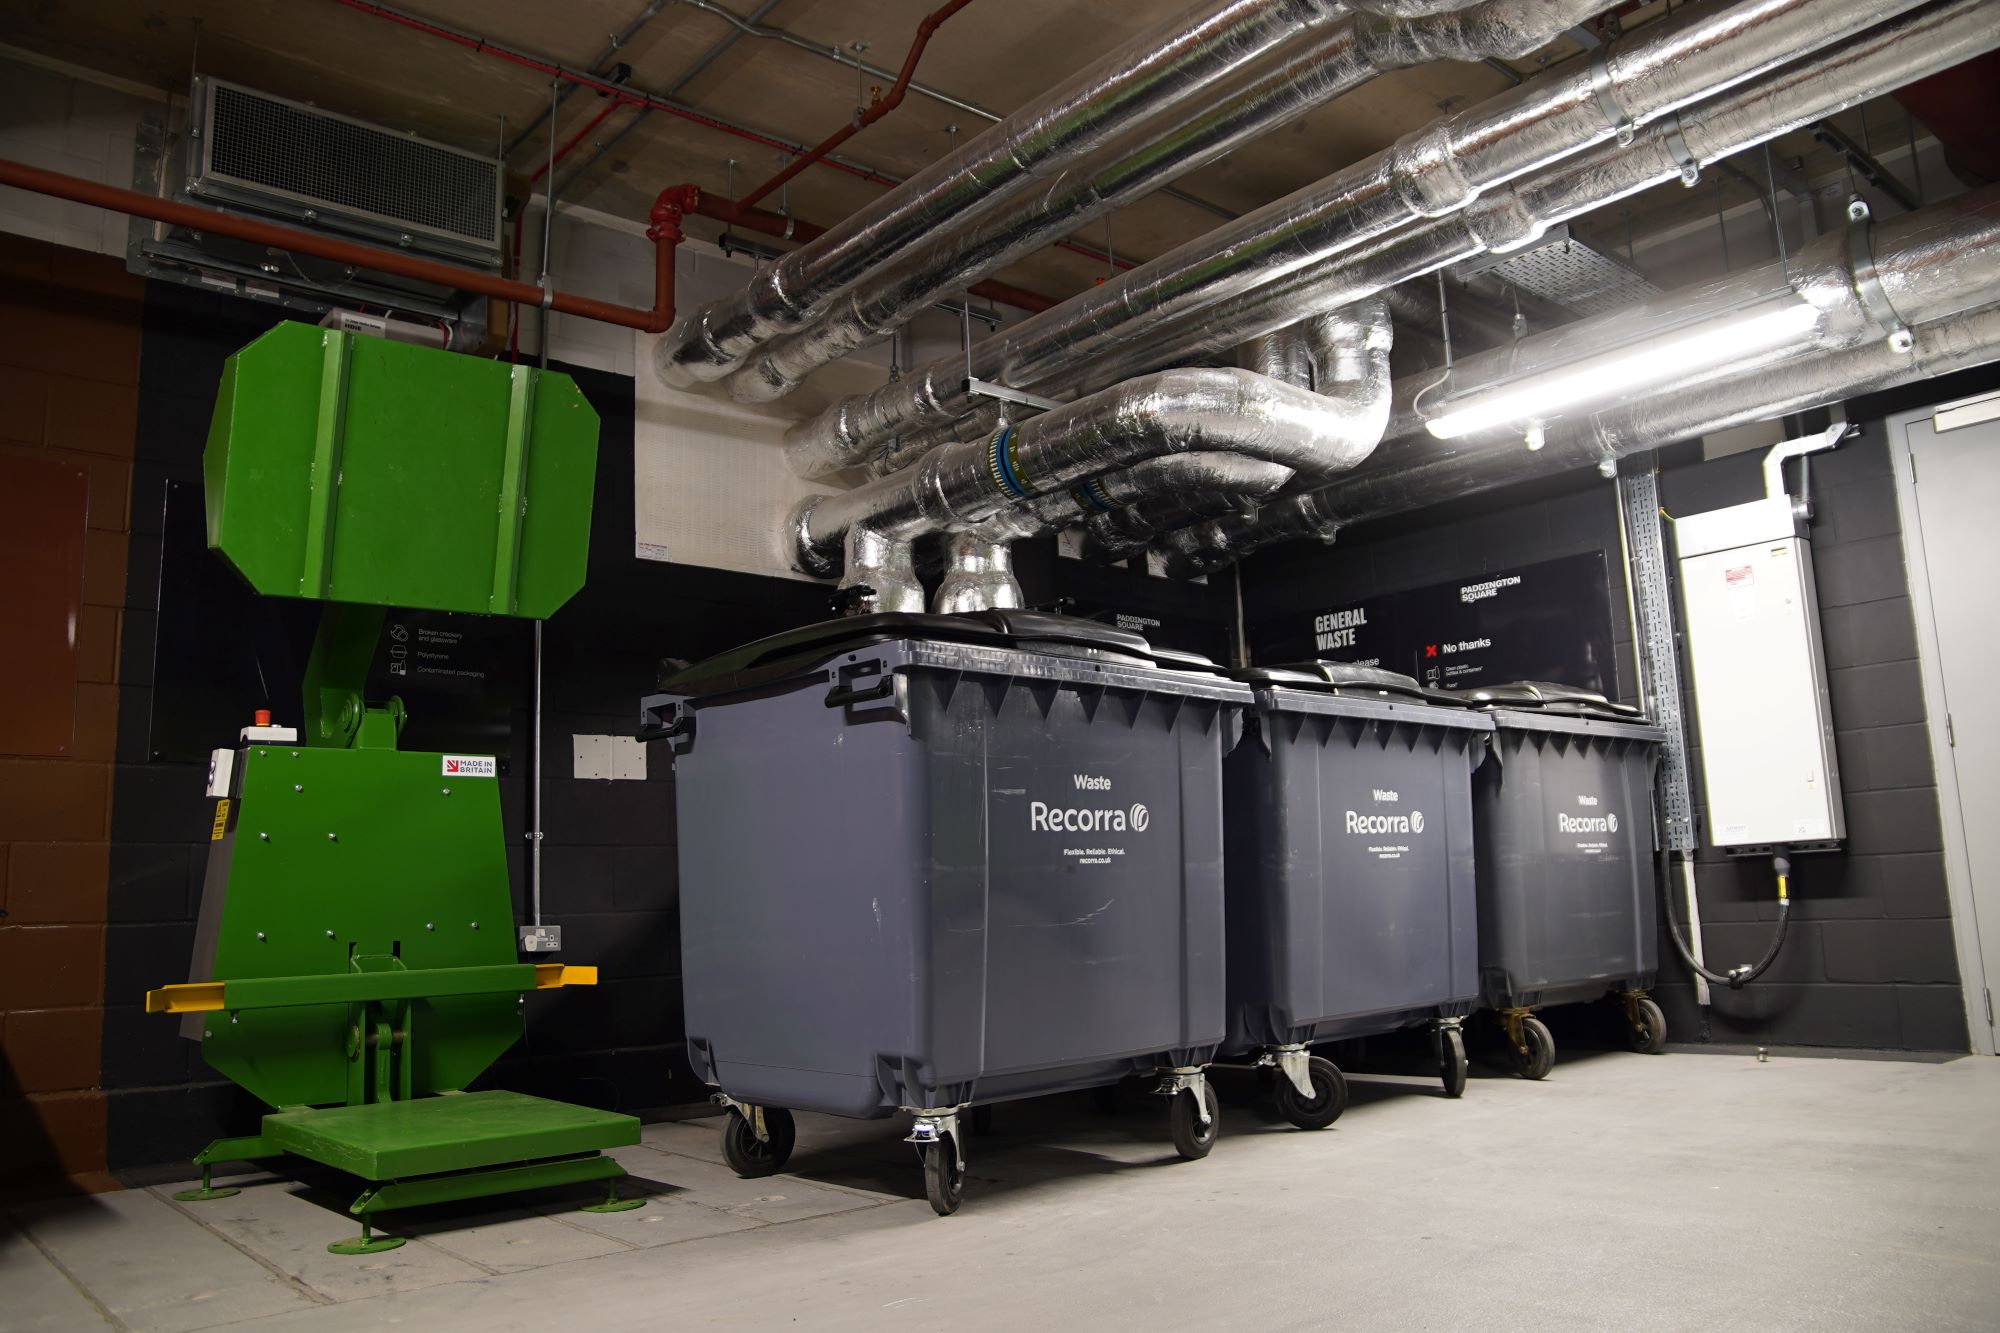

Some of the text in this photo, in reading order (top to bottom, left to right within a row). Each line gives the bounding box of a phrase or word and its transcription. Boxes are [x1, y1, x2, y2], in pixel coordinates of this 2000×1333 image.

[1460, 575, 1521, 594] PADDINGTON
[1461, 588, 1498, 603] SQUARE
[1116, 613, 1161, 627] PADDINGTON
[1116, 620, 1144, 631] SQUARE
[1315, 607, 1368, 633] GENERAL
[1315, 627, 1356, 651] WASTE
[1443, 638, 1492, 654] No thanks
[1073, 774, 1111, 791] Waste
[1373, 788, 1399, 802] Waste
[1578, 795, 1598, 806] Waste
[1030, 801, 1126, 832] Recorra
[1345, 810, 1410, 834] Recorra
[1558, 813, 1607, 833] Recorra
[1063, 848, 1085, 856] Flexible.
[1086, 848, 1107, 856] Reliable.
